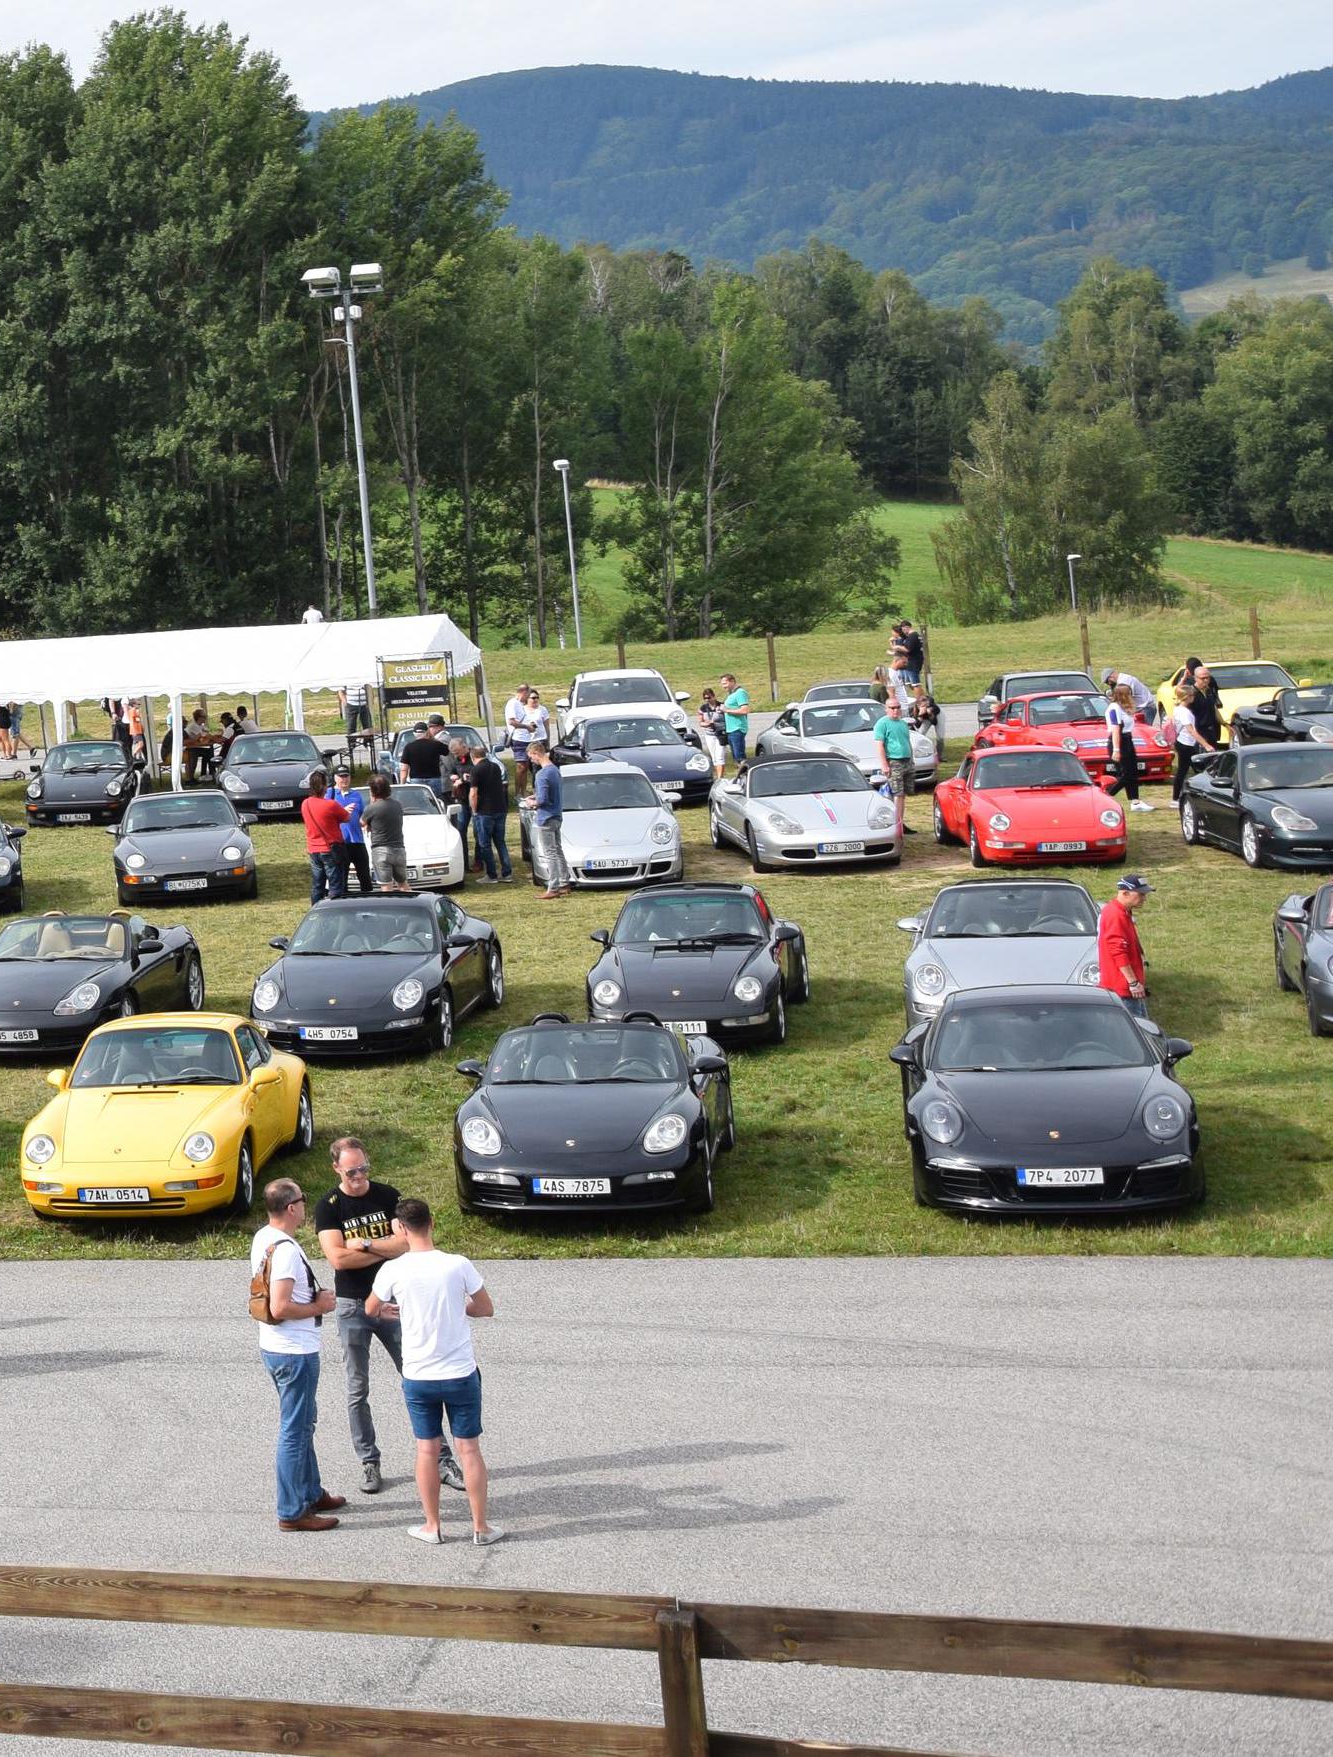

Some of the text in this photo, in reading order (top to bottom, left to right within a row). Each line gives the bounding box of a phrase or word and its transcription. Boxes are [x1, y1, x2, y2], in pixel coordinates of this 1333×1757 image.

[388, 673, 442, 684] CLASSIC EXPO
[844, 843, 862, 851] 2000
[13, 1030, 34, 1040] 4858
[308, 1029, 353, 1039] 4H5 0754
[1029, 1170, 1095, 1182] 7P4 2077
[543, 1180, 604, 1192] 4AS 7875
[87, 1189, 143, 1200] 7AH 0514
